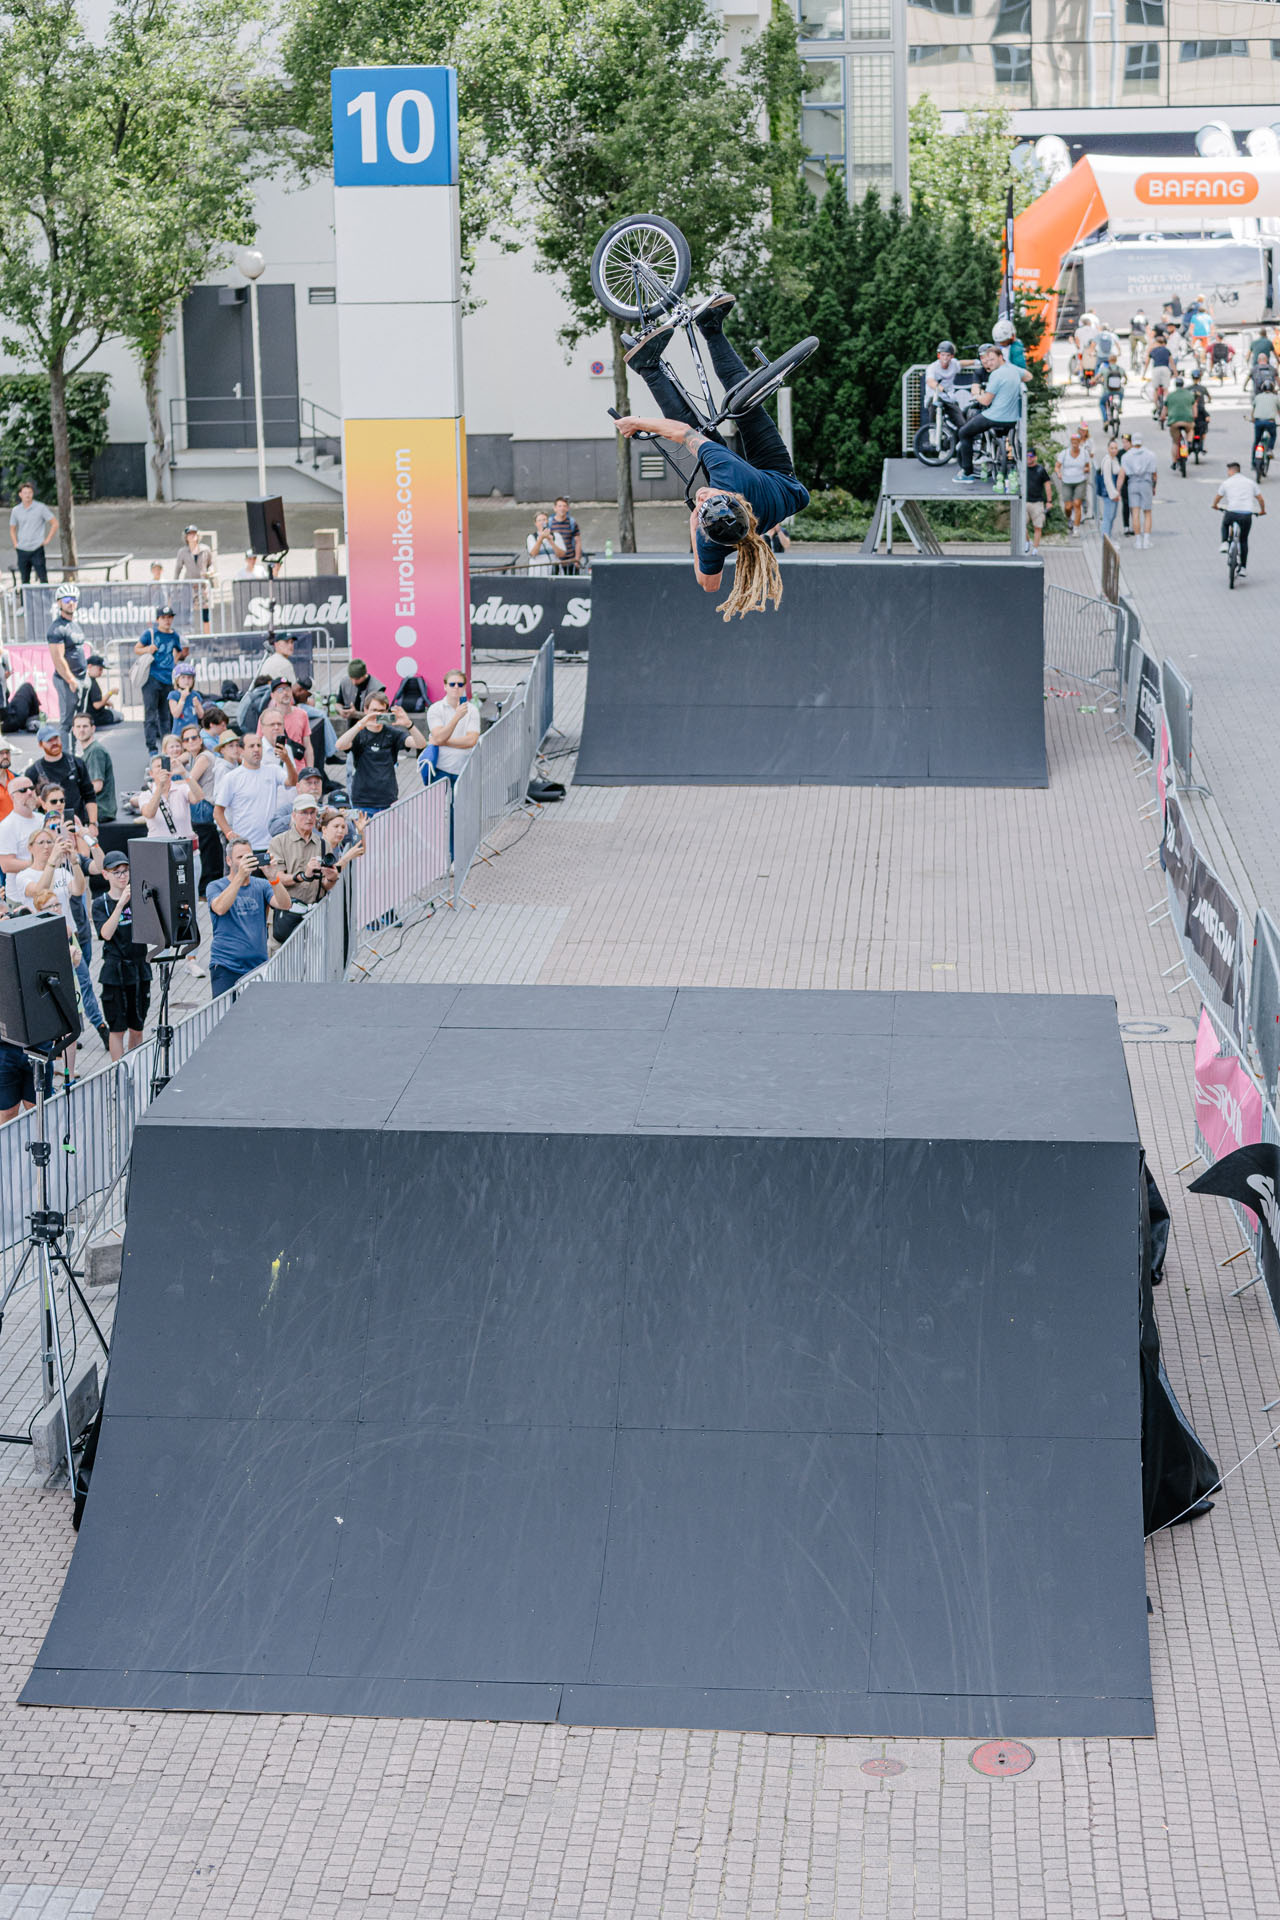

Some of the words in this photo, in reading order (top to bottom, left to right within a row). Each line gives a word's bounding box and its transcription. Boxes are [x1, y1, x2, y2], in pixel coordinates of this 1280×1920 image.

[347, 89, 435, 164] 10
[1149, 179, 1245, 197] BAFANG
[392, 448, 416, 617] Eurobike.com
